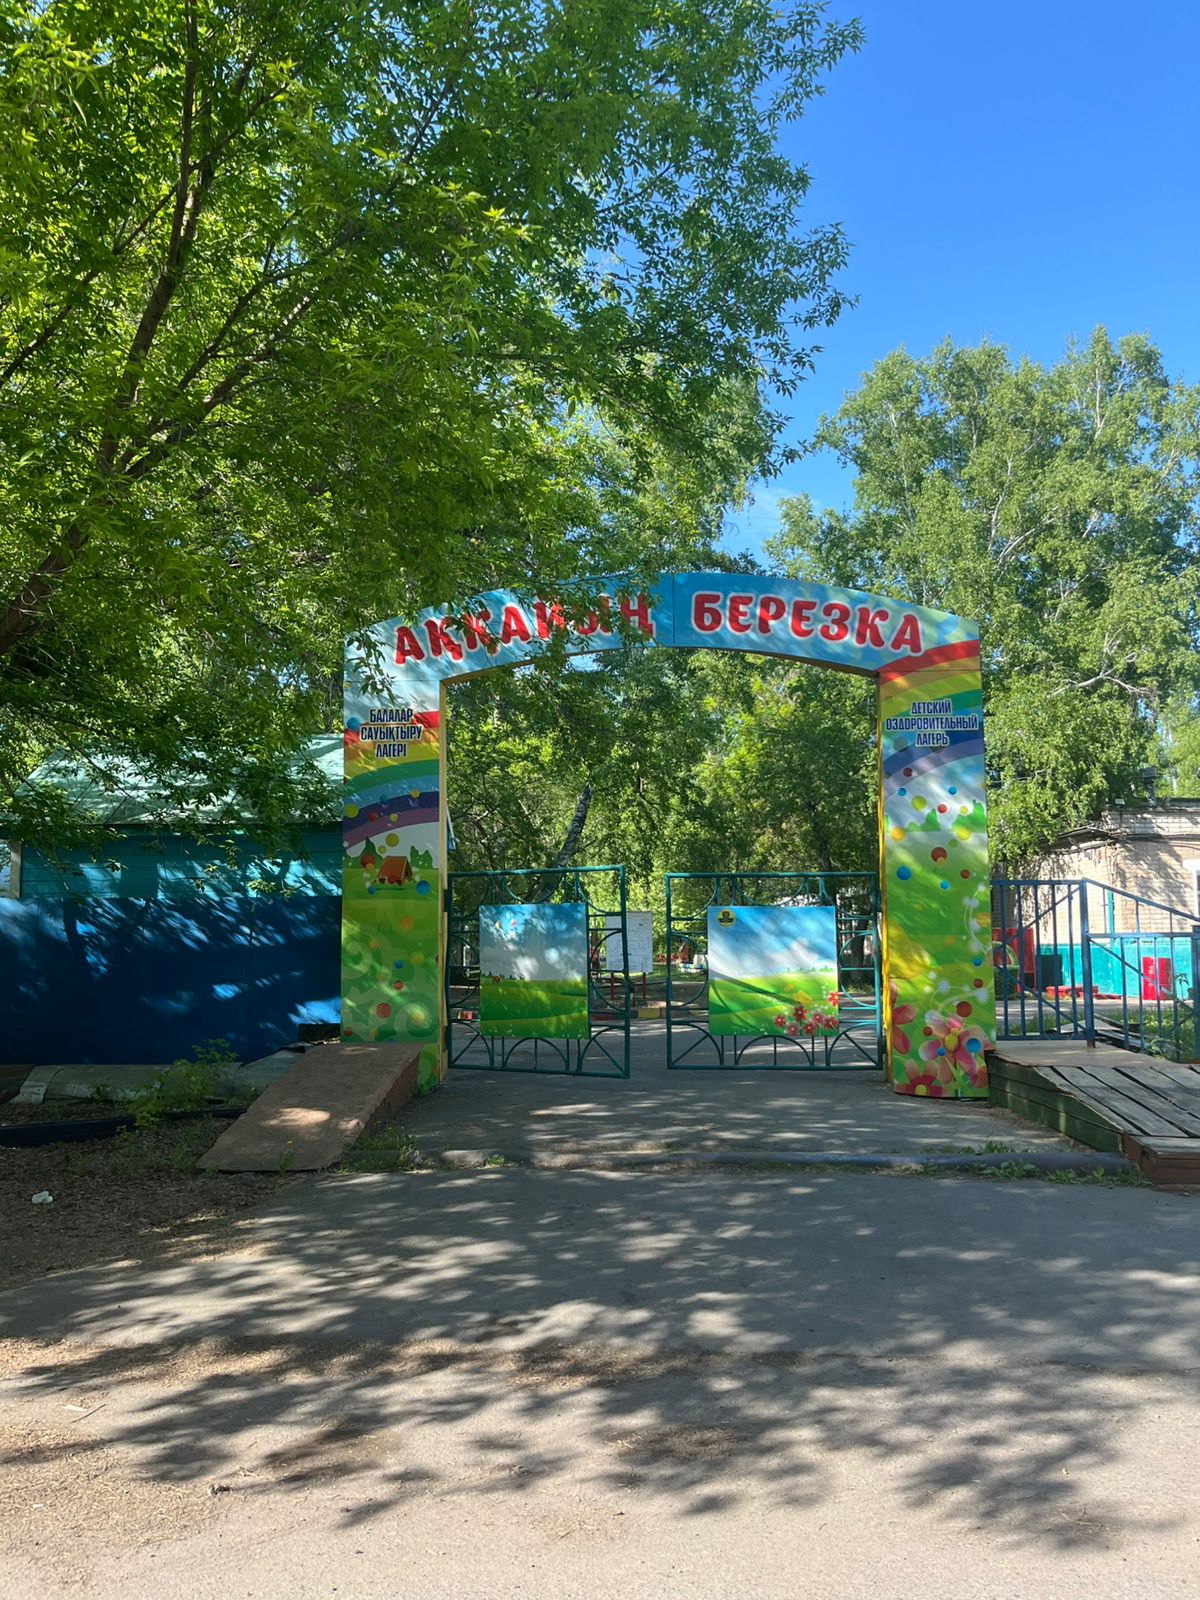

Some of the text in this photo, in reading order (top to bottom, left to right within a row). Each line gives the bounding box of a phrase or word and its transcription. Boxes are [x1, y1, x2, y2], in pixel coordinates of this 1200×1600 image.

[692, 594, 923, 654] БЕРЕЗКА
[911, 700, 951, 714] ДЕТСКИЙ
[369, 708, 413, 723] БАЛАЛАР
[886, 715, 978, 730] ОЗДОРОВИТЕЛЬНЫЙ
[360, 725, 422, 742] САУЫҚТЫРУ
[916, 732, 948, 746] ЛАГЕРЬ
[375, 743, 407, 758] ЛАГЕРІ
